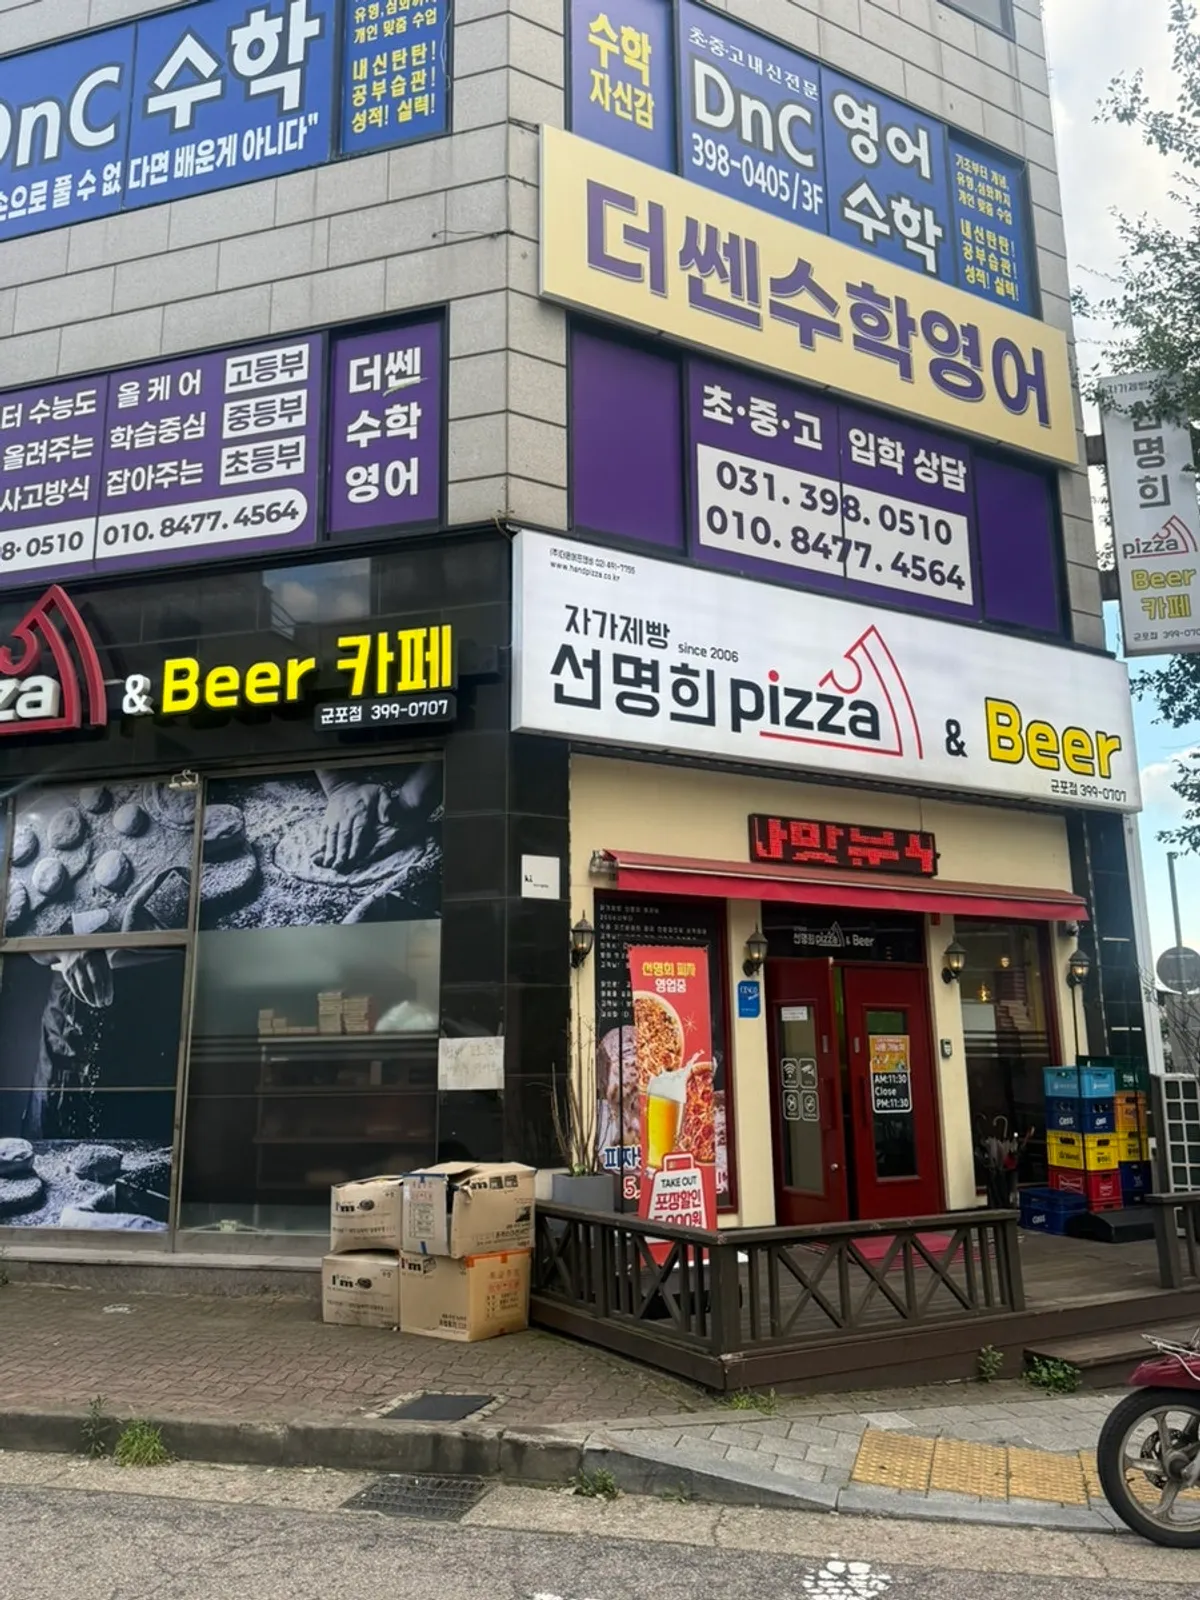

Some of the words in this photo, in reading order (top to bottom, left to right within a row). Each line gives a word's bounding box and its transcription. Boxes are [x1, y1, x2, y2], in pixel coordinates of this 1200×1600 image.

[354, 23, 378, 43] 개인
[383, 16, 407, 37] 맞춤
[412, 7, 437, 28] 수업
[588, 13, 653, 87] 수학
[0, 66, 120, 166] nC
[148, 0, 320, 130] 수학
[590, 68, 655, 130] 자신감
[352, 104, 389, 133] 성적!
[397, 93, 435, 122] 실력!
[694, 58, 815, 168] DnC
[833, 93, 932, 179] 영어
[53, 174, 73, 209] 풀
[174, 134, 238, 180] 배운게
[843, 182, 943, 274] 수학
[587, 179, 1052, 429] 더쎈수학영어
[229, 350, 305, 388] 고등부
[349, 347, 422, 394] 더쎈
[28, 390, 96, 425] 수능도
[227, 394, 303, 432] 중등부
[346, 402, 422, 448] 수학
[110, 411, 206, 450] 학습중심
[3, 434, 95, 472] 올려주는
[225, 440, 301, 478] 초등부
[848, 428, 905, 476] 입학
[913, 449, 966, 493] 상담
[0, 474, 90, 513] 사고방식
[106, 459, 204, 497] 잡아주는
[345, 457, 419, 504] 영어
[1123, 537, 1179, 560] pizza
[1131, 569, 1197, 591] Beer
[1141, 594, 1191, 620] 카페
[565, 604, 671, 650] 자가제빵
[122, 673, 153, 716] &
[163, 657, 316, 713] Beer
[337, 624, 452, 697] 카페
[678, 642, 708, 658] since
[710, 647, 740, 663] 2006
[321, 706, 362, 724] 군포점
[370, 700, 448, 720] 399-0707
[550, 643, 716, 727] 선명희
[730, 669, 880, 742] pizza
[945, 718, 968, 758] &
[984, 696, 1123, 779] Beer
[1051, 779, 1078, 796] 군포점
[655, 978, 686, 993] 영업중
[875, 1086, 897, 1096] Close
[654, 1189, 701, 1211] 포장할인
[660, 1178, 681, 1188] TAKE
[682, 1175, 697, 1187] OUT
